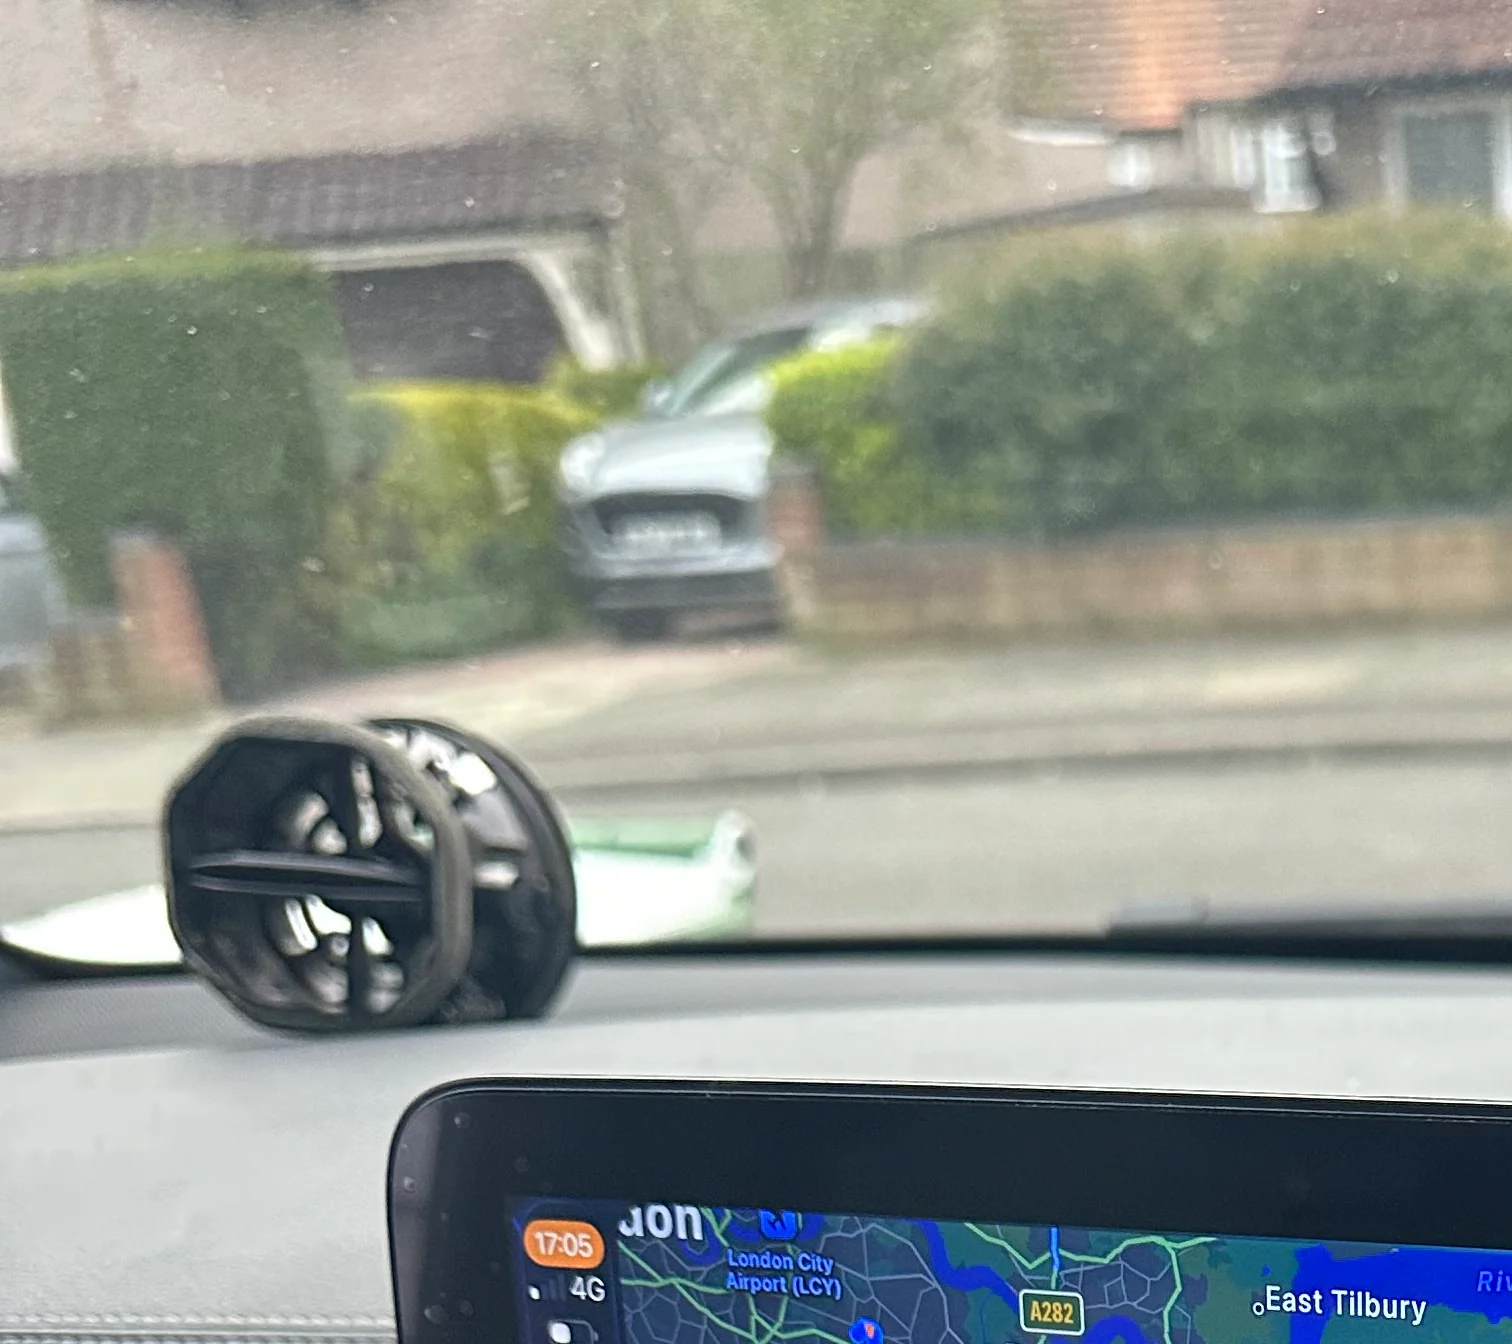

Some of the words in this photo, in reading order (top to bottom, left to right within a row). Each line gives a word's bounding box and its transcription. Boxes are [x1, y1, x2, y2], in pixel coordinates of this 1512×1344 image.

[533, 1231, 593, 1258] 17:05
[727, 1249, 793, 1271] London
[797, 1252, 834, 1276] City
[569, 1276, 606, 1302] 4G
[726, 1273, 788, 1296] Airport
[791, 1277, 842, 1300] (LCY)
[1030, 1301, 1074, 1324] A282
[1265, 1286, 1323, 1315] East
[1331, 1290, 1427, 1326] Tilbury
